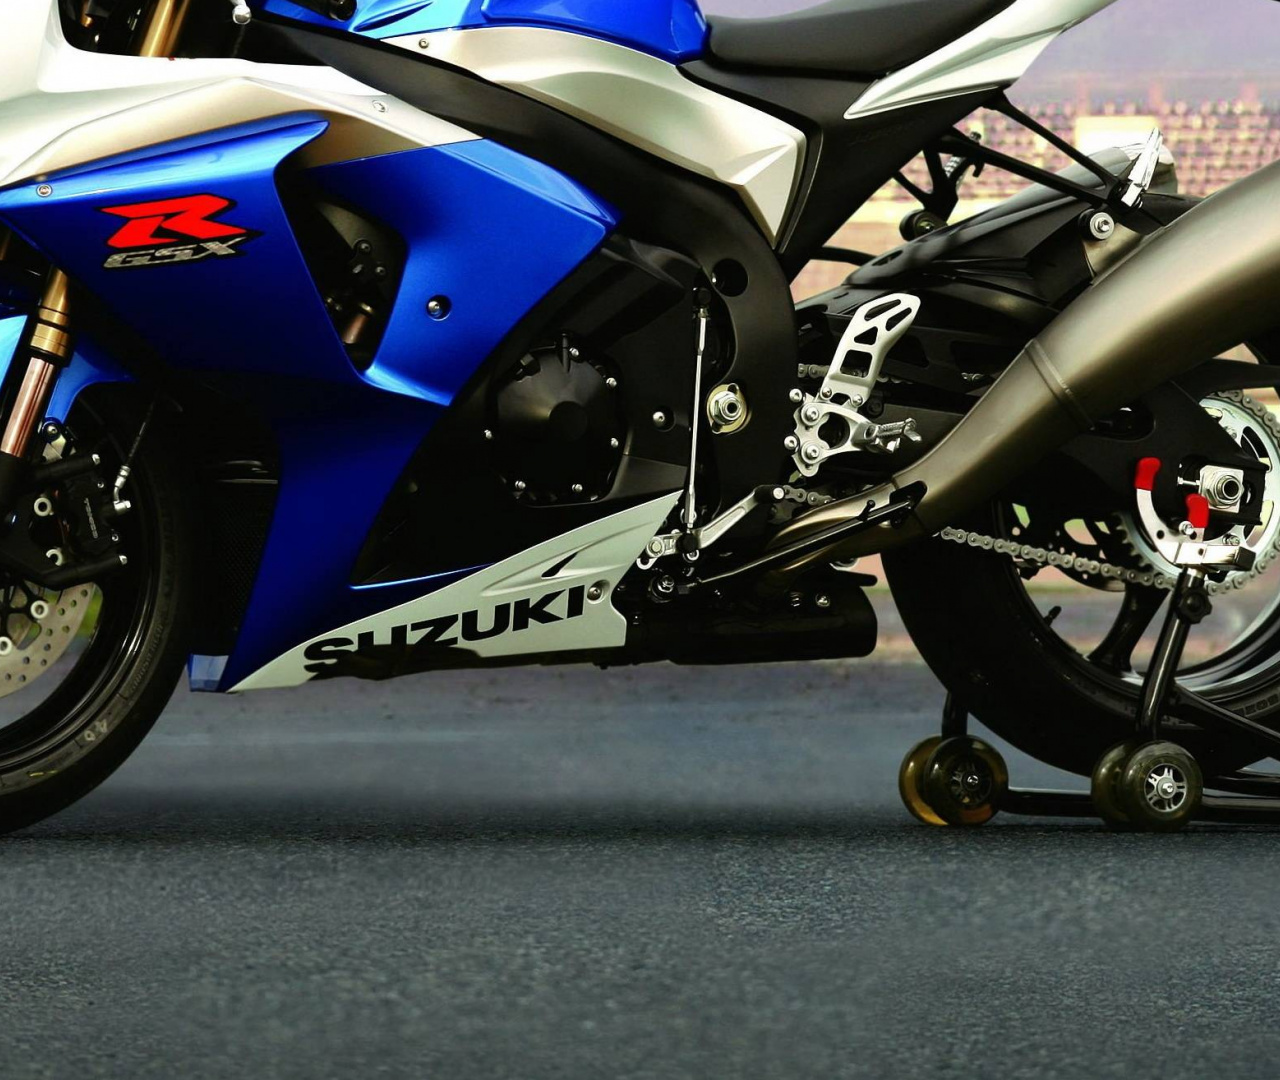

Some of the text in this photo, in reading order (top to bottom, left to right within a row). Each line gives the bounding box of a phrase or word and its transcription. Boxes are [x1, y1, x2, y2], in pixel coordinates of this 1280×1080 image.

[99, 192, 250, 249] R
[103, 237, 248, 268] GSX
[304, 585, 585, 674] SUZUKI
